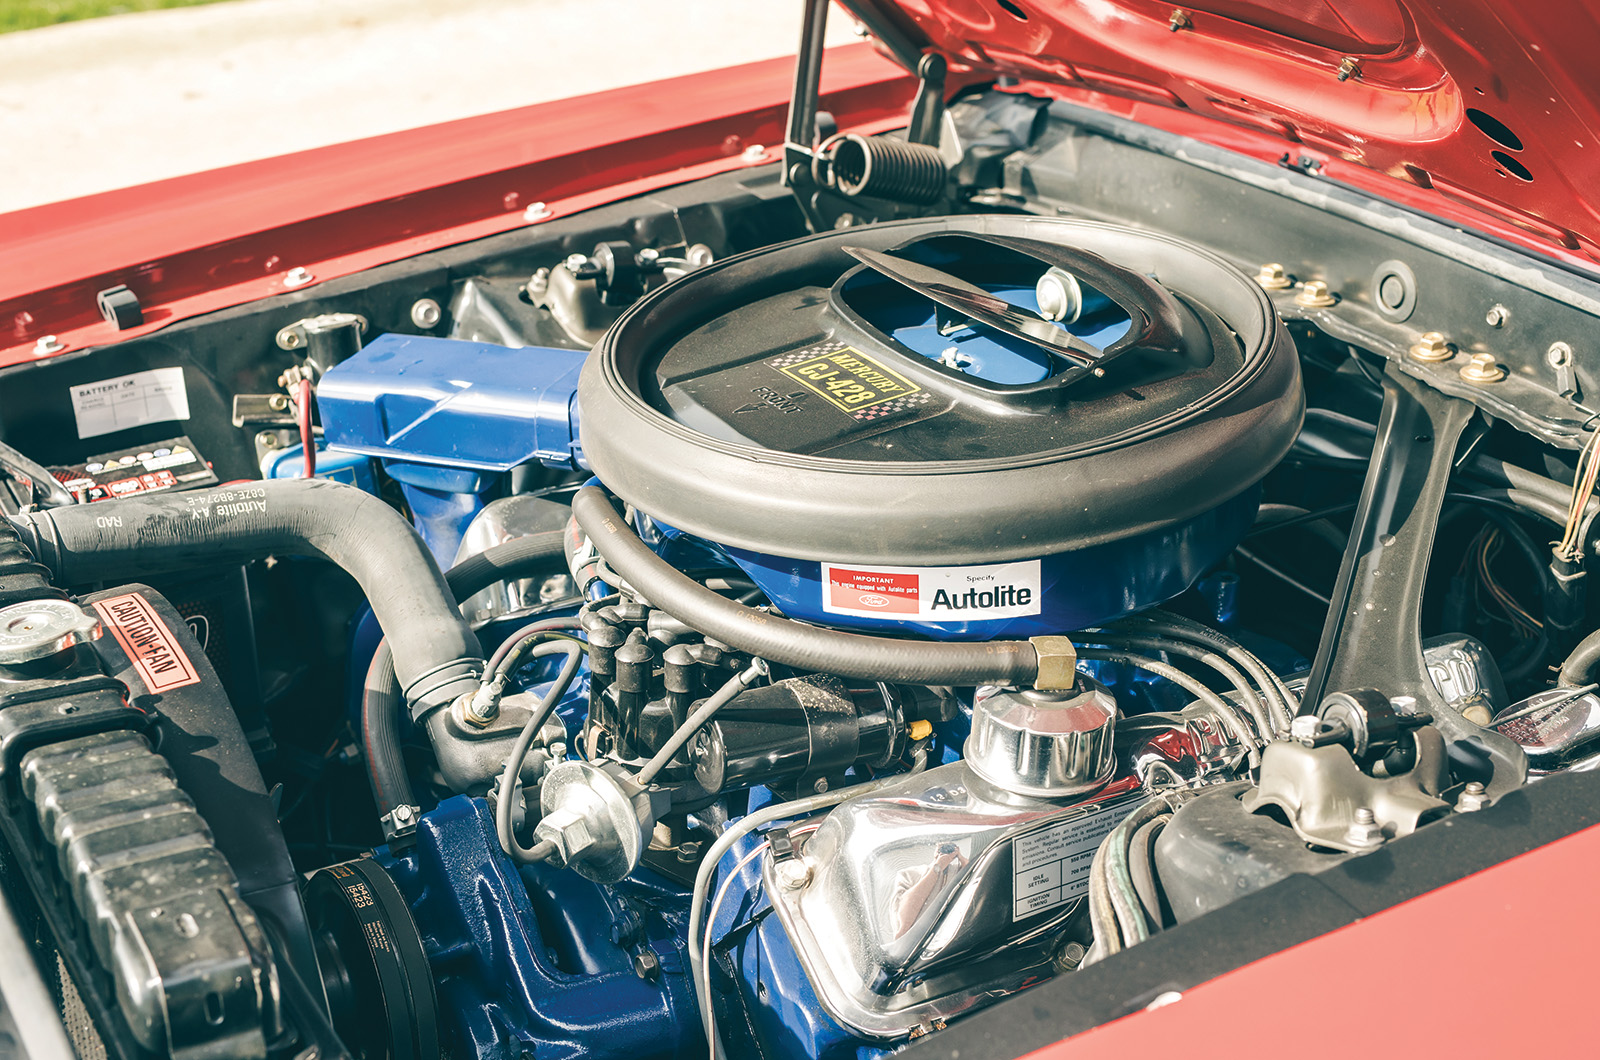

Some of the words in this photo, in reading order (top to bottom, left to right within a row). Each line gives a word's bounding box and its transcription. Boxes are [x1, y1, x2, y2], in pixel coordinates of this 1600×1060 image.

[828, 354, 905, 393] MERCURY
[79, 384, 119, 397] BATTERY
[122, 379, 136, 388] OK
[750, 386, 804, 414] FRONT
[216, 500, 267, 517] Autolite
[97, 516, 123, 528] RAD
[853, 575, 894, 584] IMPORTANT
[966, 575, 995, 583] Specify
[931, 585, 1032, 611] Autolite
[1034, 834, 1050, 843] vehicle
[1052, 830, 1061, 838] has
[1071, 821, 1093, 832] approved
[1095, 814, 1113, 824] Exhaust
[1114, 807, 1135, 818] Emission
[1042, 838, 1059, 847] Regular
[1062, 833, 1078, 841] service
[1086, 822, 1106, 833] essential
[1047, 843, 1065, 852] Consult
[1065, 838, 1082, 847] service
[1082, 829, 1109, 842] publications
[1028, 877, 1050, 888] SETTING
[1032, 873, 1044, 881] IDLE
[347, 885, 366, 908] 15423
[356, 882, 374, 906] 15423
[1027, 893, 1050, 904] IGNITION
[1030, 899, 1048, 909] TIMING
